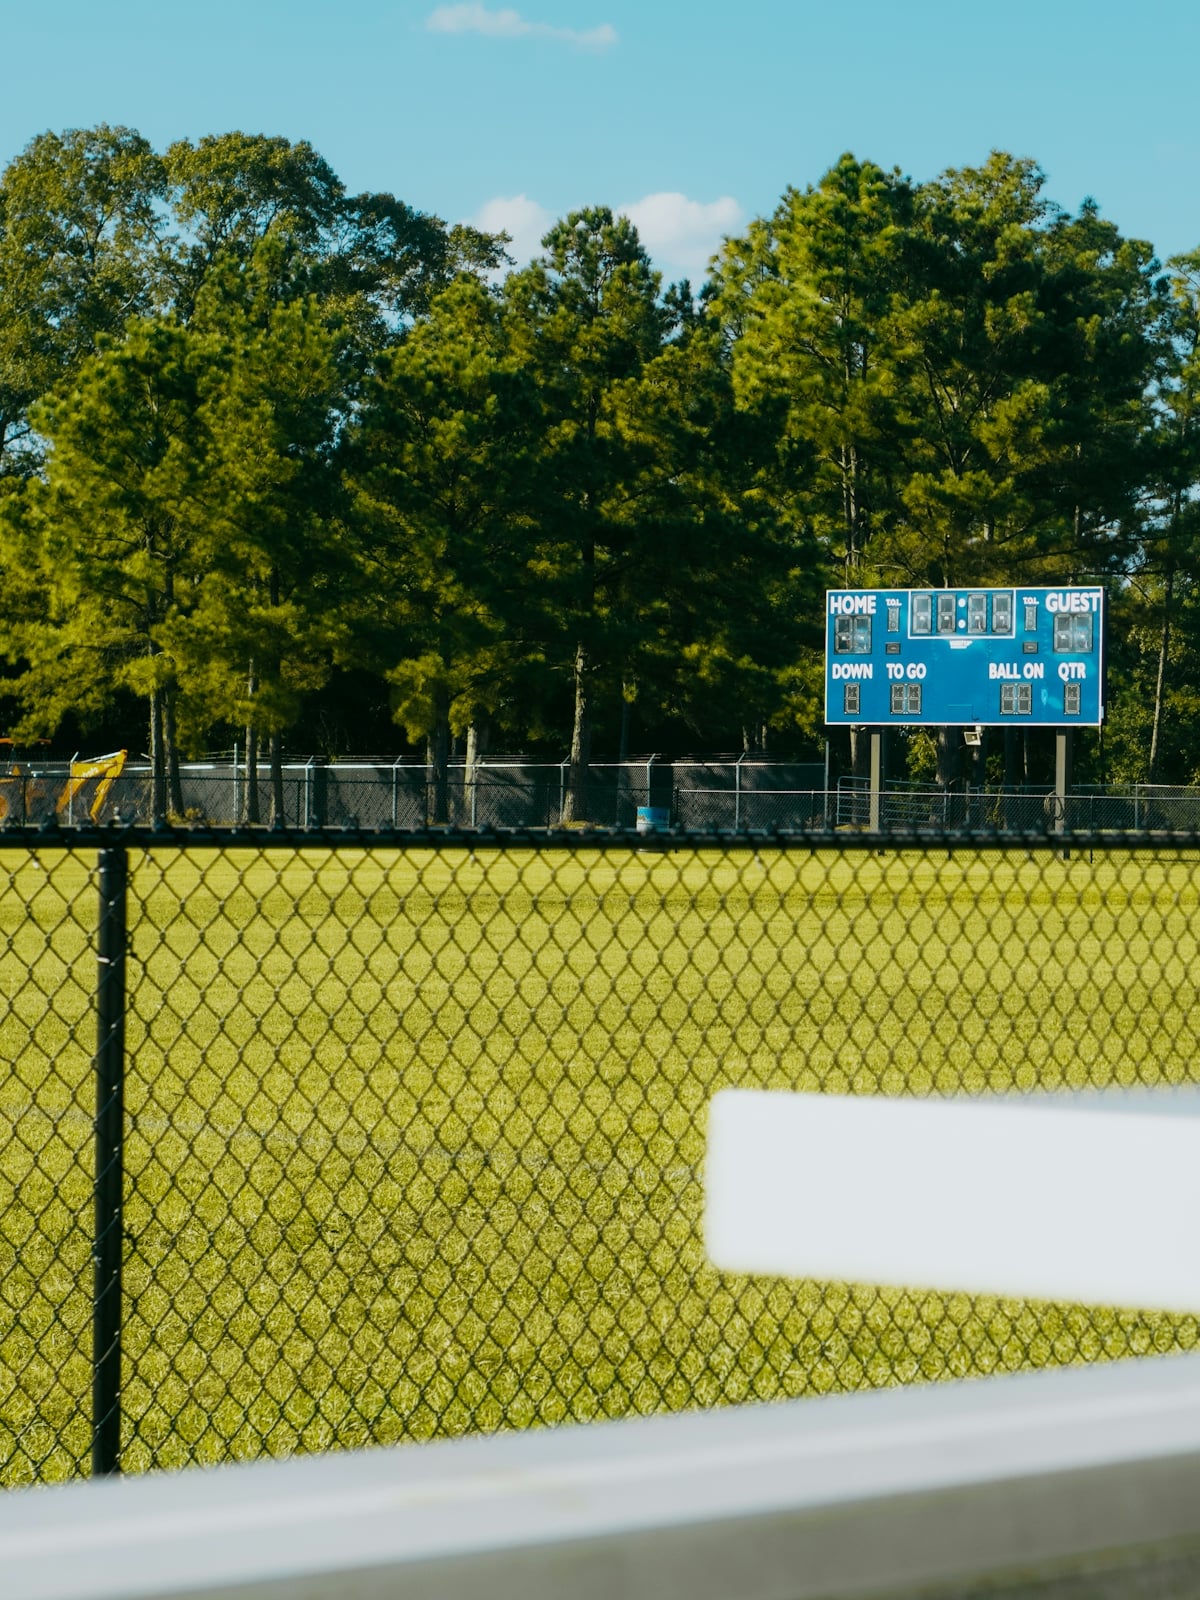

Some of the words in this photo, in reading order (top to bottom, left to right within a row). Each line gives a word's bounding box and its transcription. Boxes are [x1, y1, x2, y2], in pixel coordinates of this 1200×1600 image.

[830, 595, 877, 614] HOME
[1045, 592, 1101, 612] GUEST
[832, 663, 873, 679] DOWN
[886, 663, 904, 679] TO
[907, 662, 927, 679] GO
[989, 662, 1021, 679] BALL
[1023, 662, 1044, 679] ON
[1058, 662, 1086, 682] QTR
